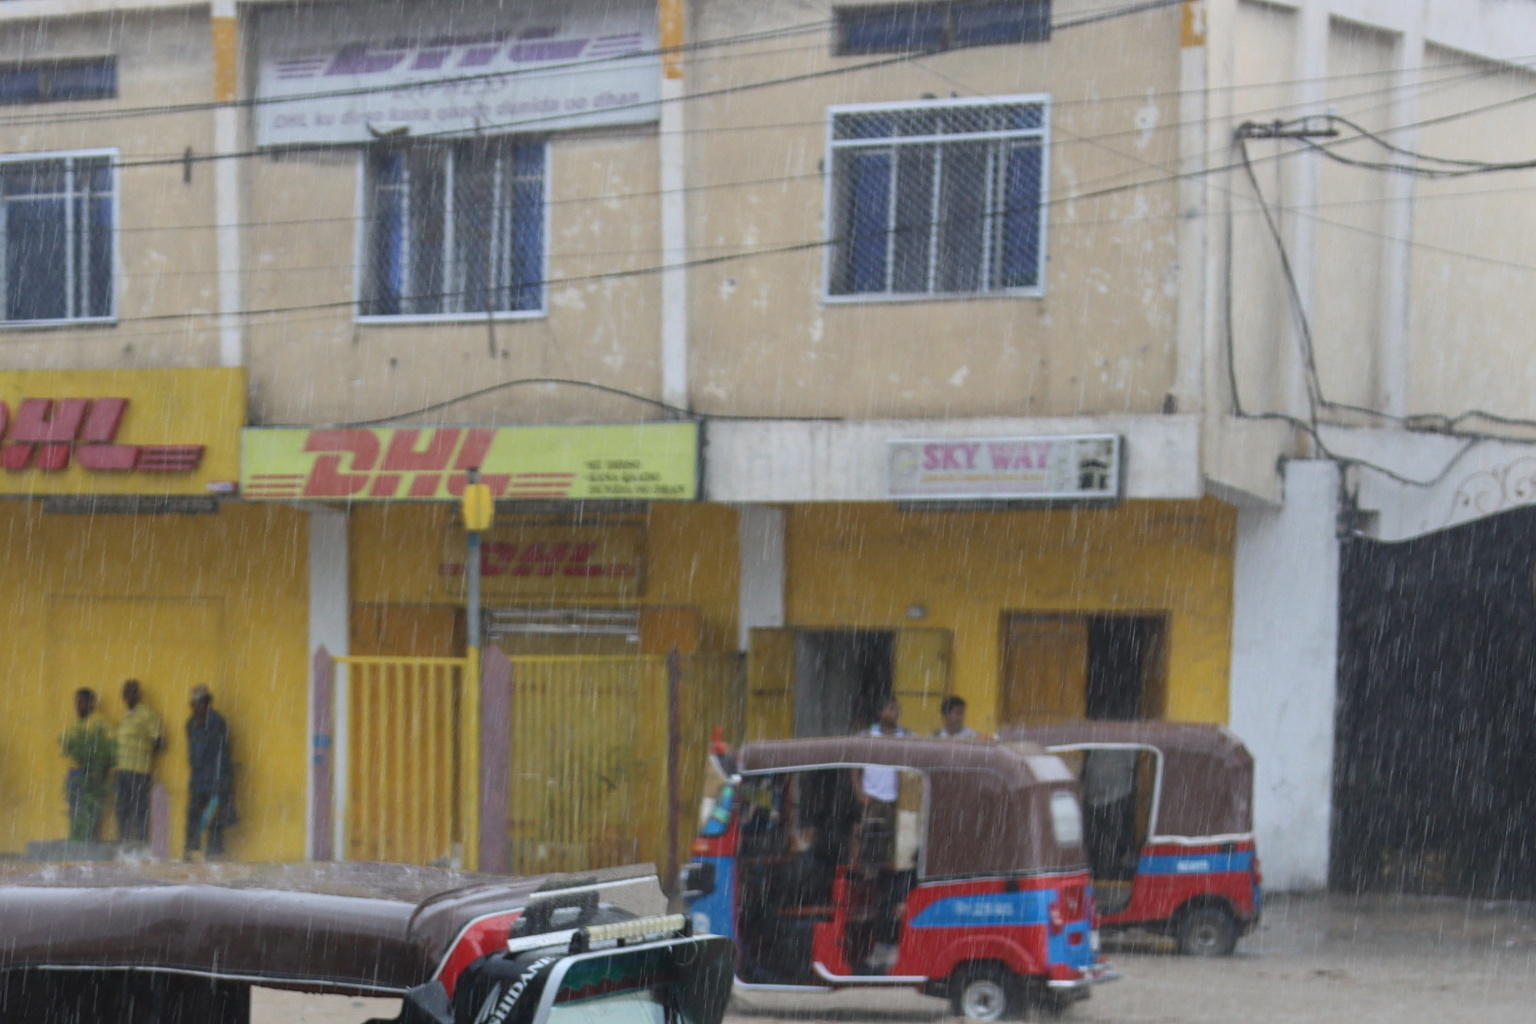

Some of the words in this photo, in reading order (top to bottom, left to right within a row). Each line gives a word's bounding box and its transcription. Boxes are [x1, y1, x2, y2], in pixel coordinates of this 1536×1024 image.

[303, 428, 513, 497] DHL
[922, 443, 980, 470] SKY
[988, 442, 1054, 470] WAY
[479, 541, 604, 577] DHL
